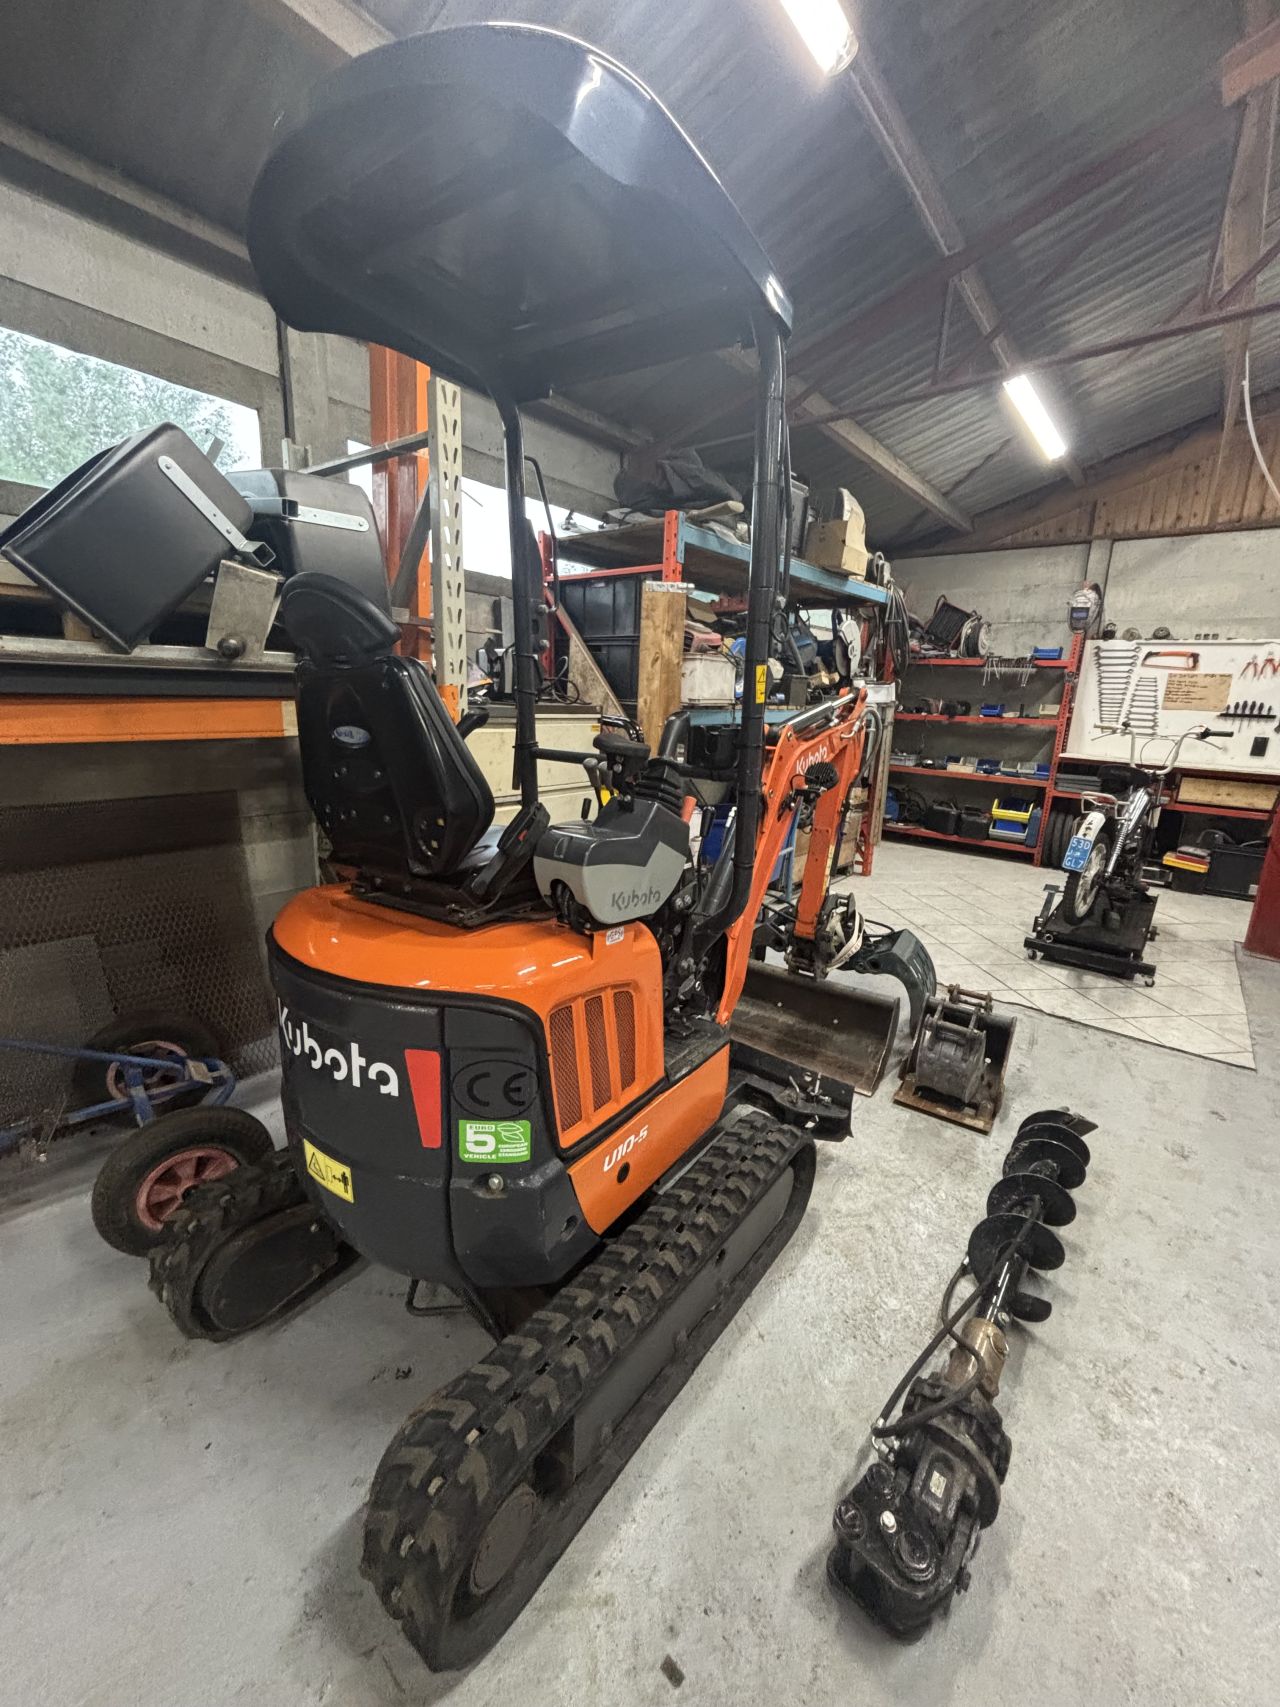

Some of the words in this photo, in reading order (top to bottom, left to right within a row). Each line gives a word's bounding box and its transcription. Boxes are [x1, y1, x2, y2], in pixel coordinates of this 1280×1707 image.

[1071, 838, 1090, 849] 53D
[1065, 857, 1084, 869] GL7
[611, 886, 661, 911] Kubota
[277, 997, 399, 1097] Kubota
[466, 1072, 528, 1107] CE
[466, 1126, 496, 1153] 5
[603, 1124, 649, 1172] U10-5
